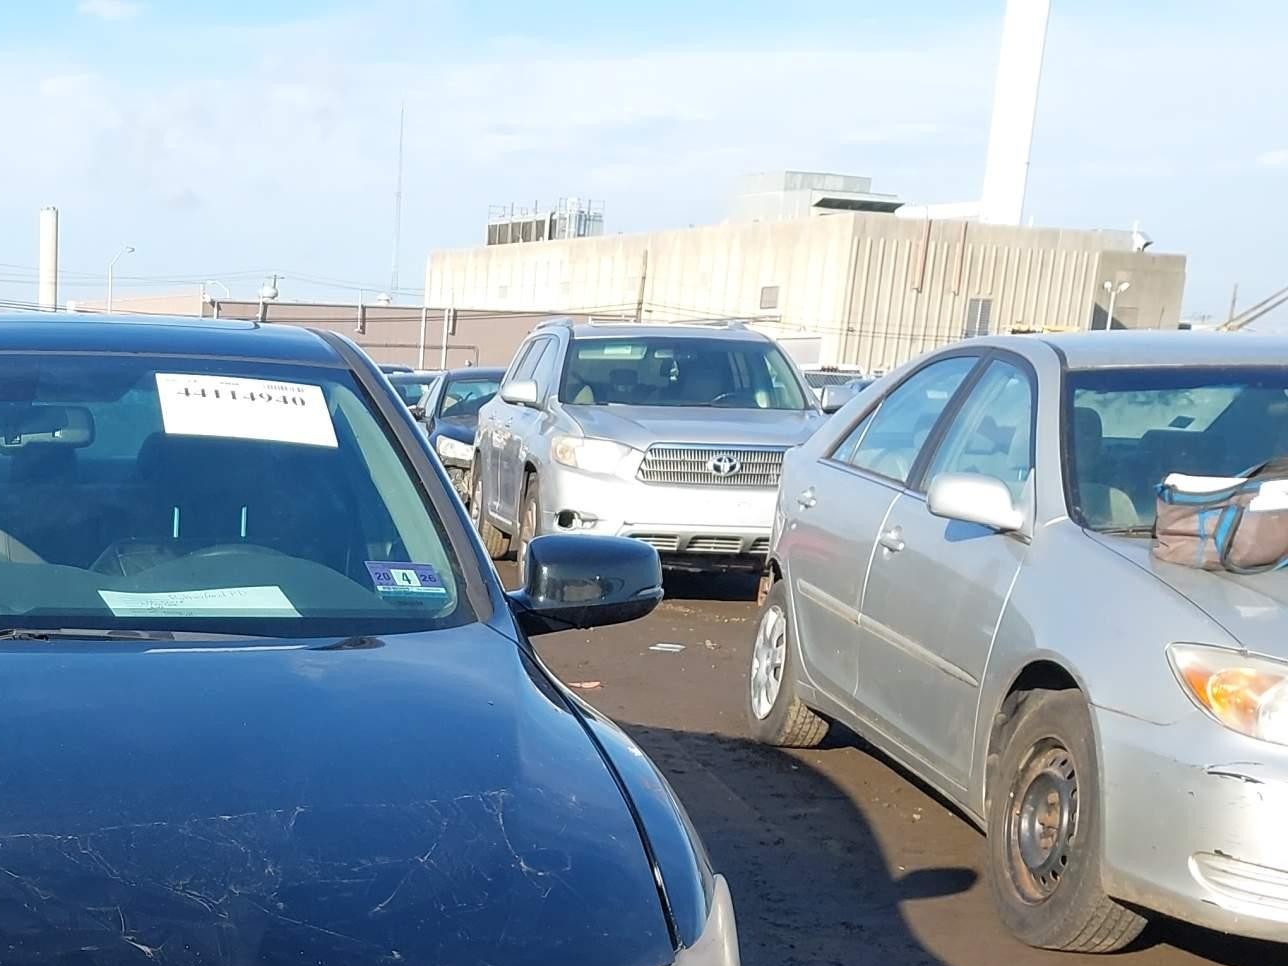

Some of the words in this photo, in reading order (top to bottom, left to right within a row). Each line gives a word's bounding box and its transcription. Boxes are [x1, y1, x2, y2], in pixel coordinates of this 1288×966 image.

[176, 386, 307, 407] 44114940
[375, 572, 391, 581] 20
[402, 572, 412, 585] 4
